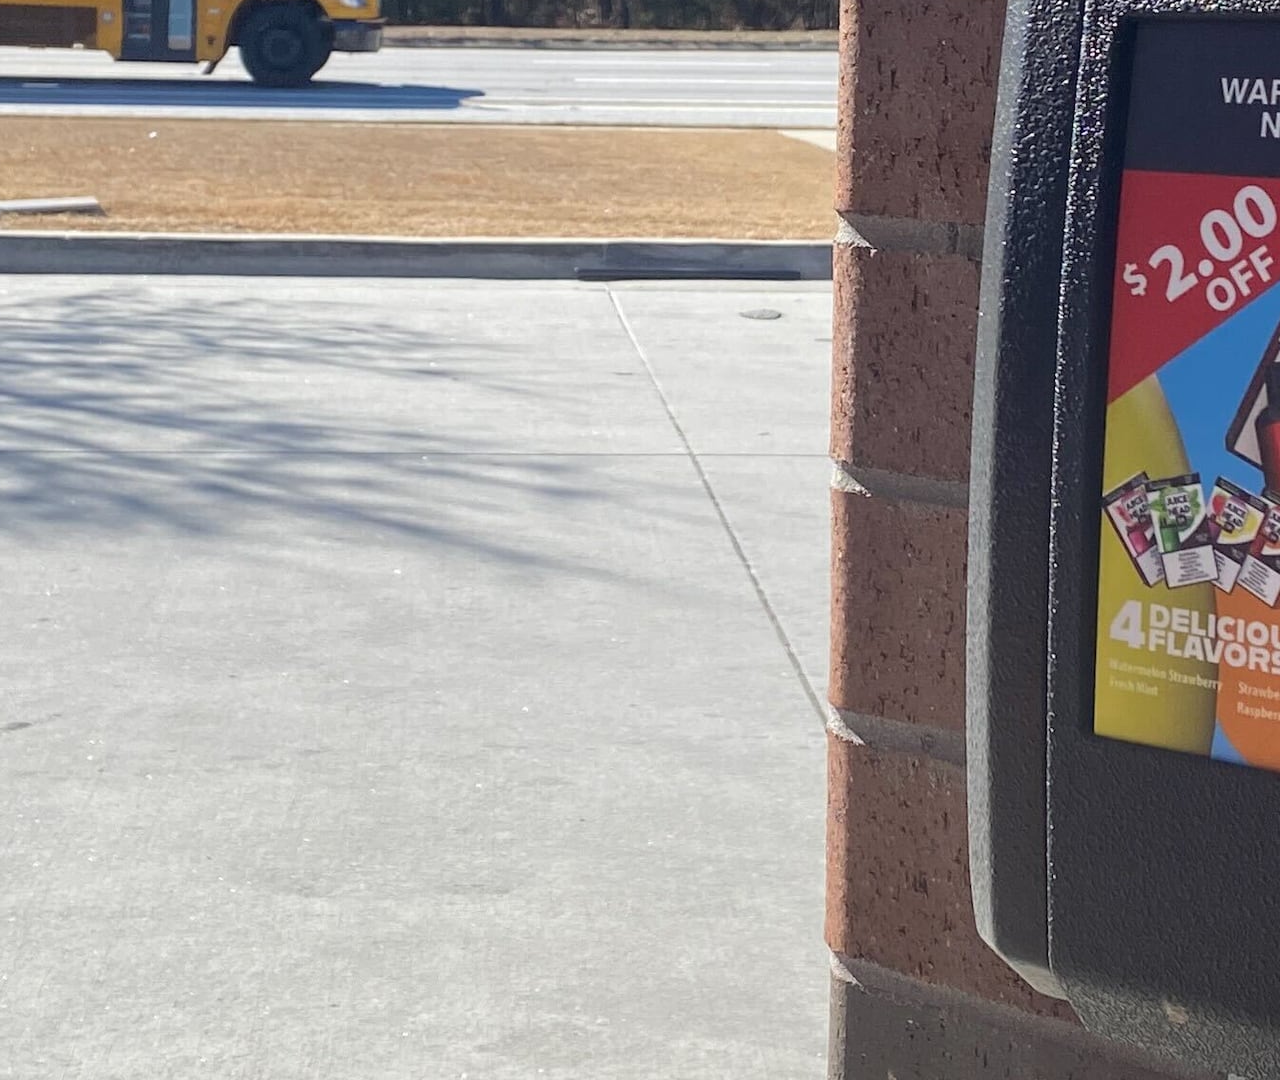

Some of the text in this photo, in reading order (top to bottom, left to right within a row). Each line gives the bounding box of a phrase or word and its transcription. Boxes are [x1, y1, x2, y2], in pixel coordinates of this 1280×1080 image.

[1122, 185, 1278, 302] $2.00
[1206, 244, 1276, 311] OFF
[1109, 599, 1146, 649] 4
[1168, 669, 1222, 691] Strawberry
